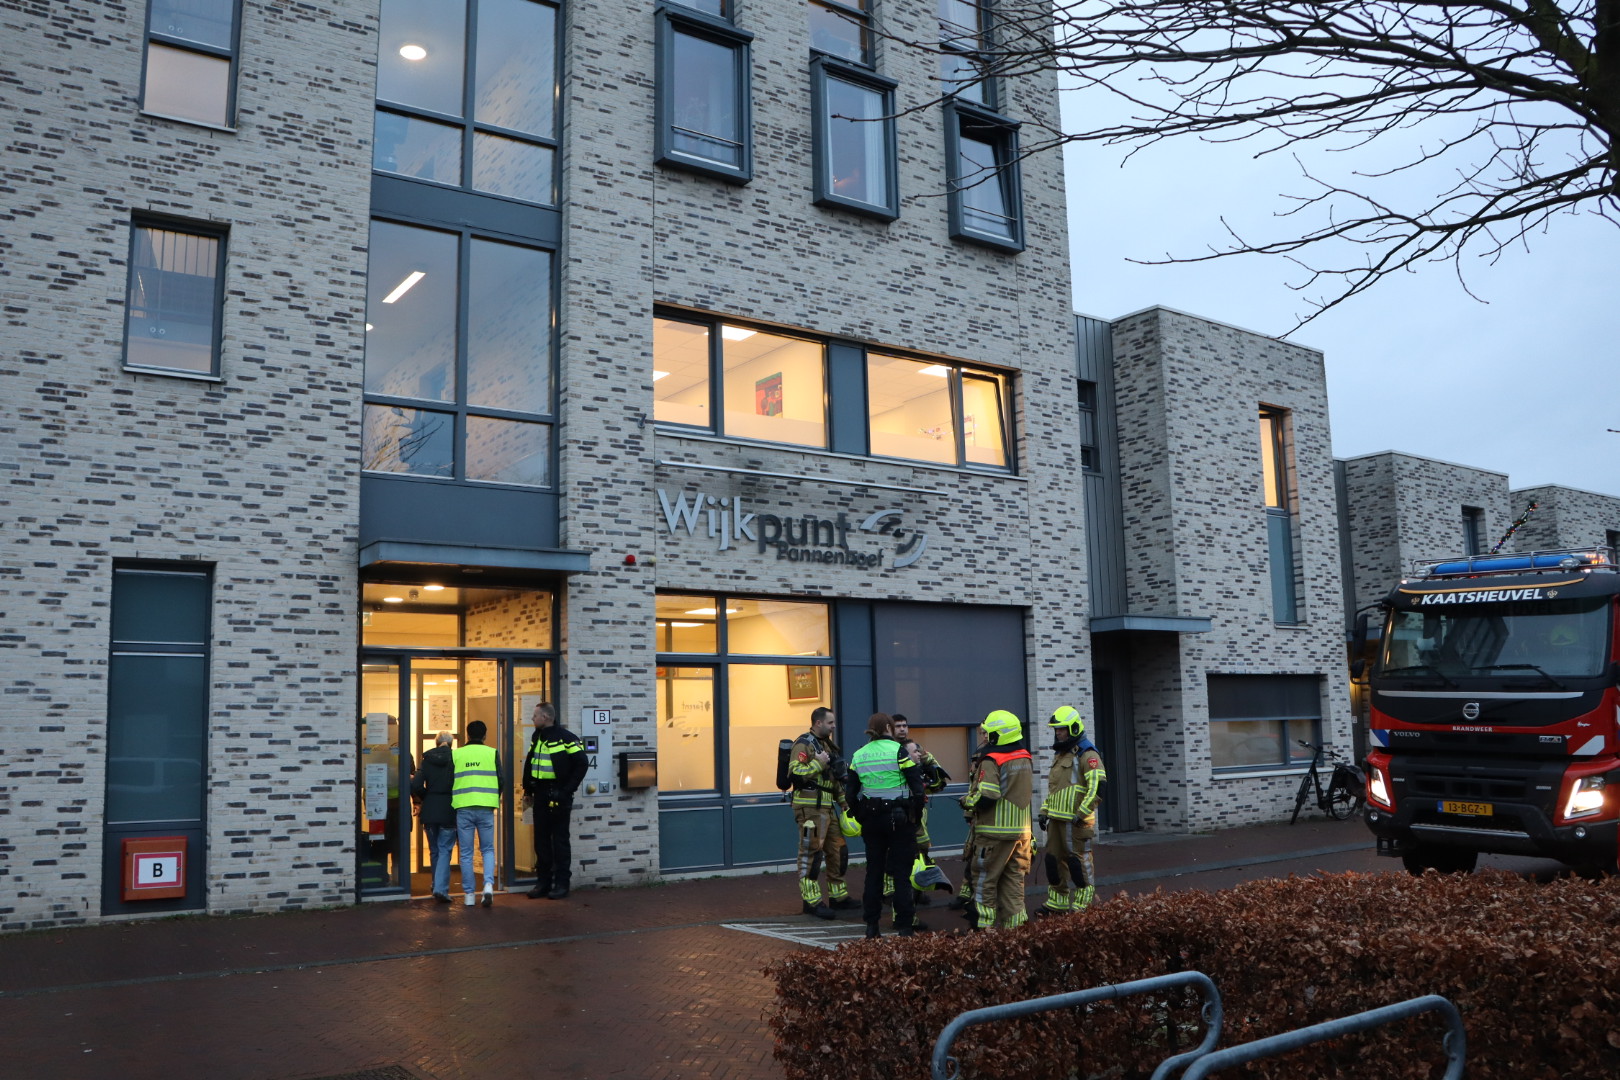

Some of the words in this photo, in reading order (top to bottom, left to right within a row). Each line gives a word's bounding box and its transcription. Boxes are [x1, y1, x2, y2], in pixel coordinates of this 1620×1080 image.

[657, 488, 851, 553] Wijkpunt
[1421, 588, 1543, 605] KAATSHEUVEL
[599, 712, 606, 722] B
[1448, 803, 1487, 813] 13-BGZ-1
[153, 863, 163, 877] B
